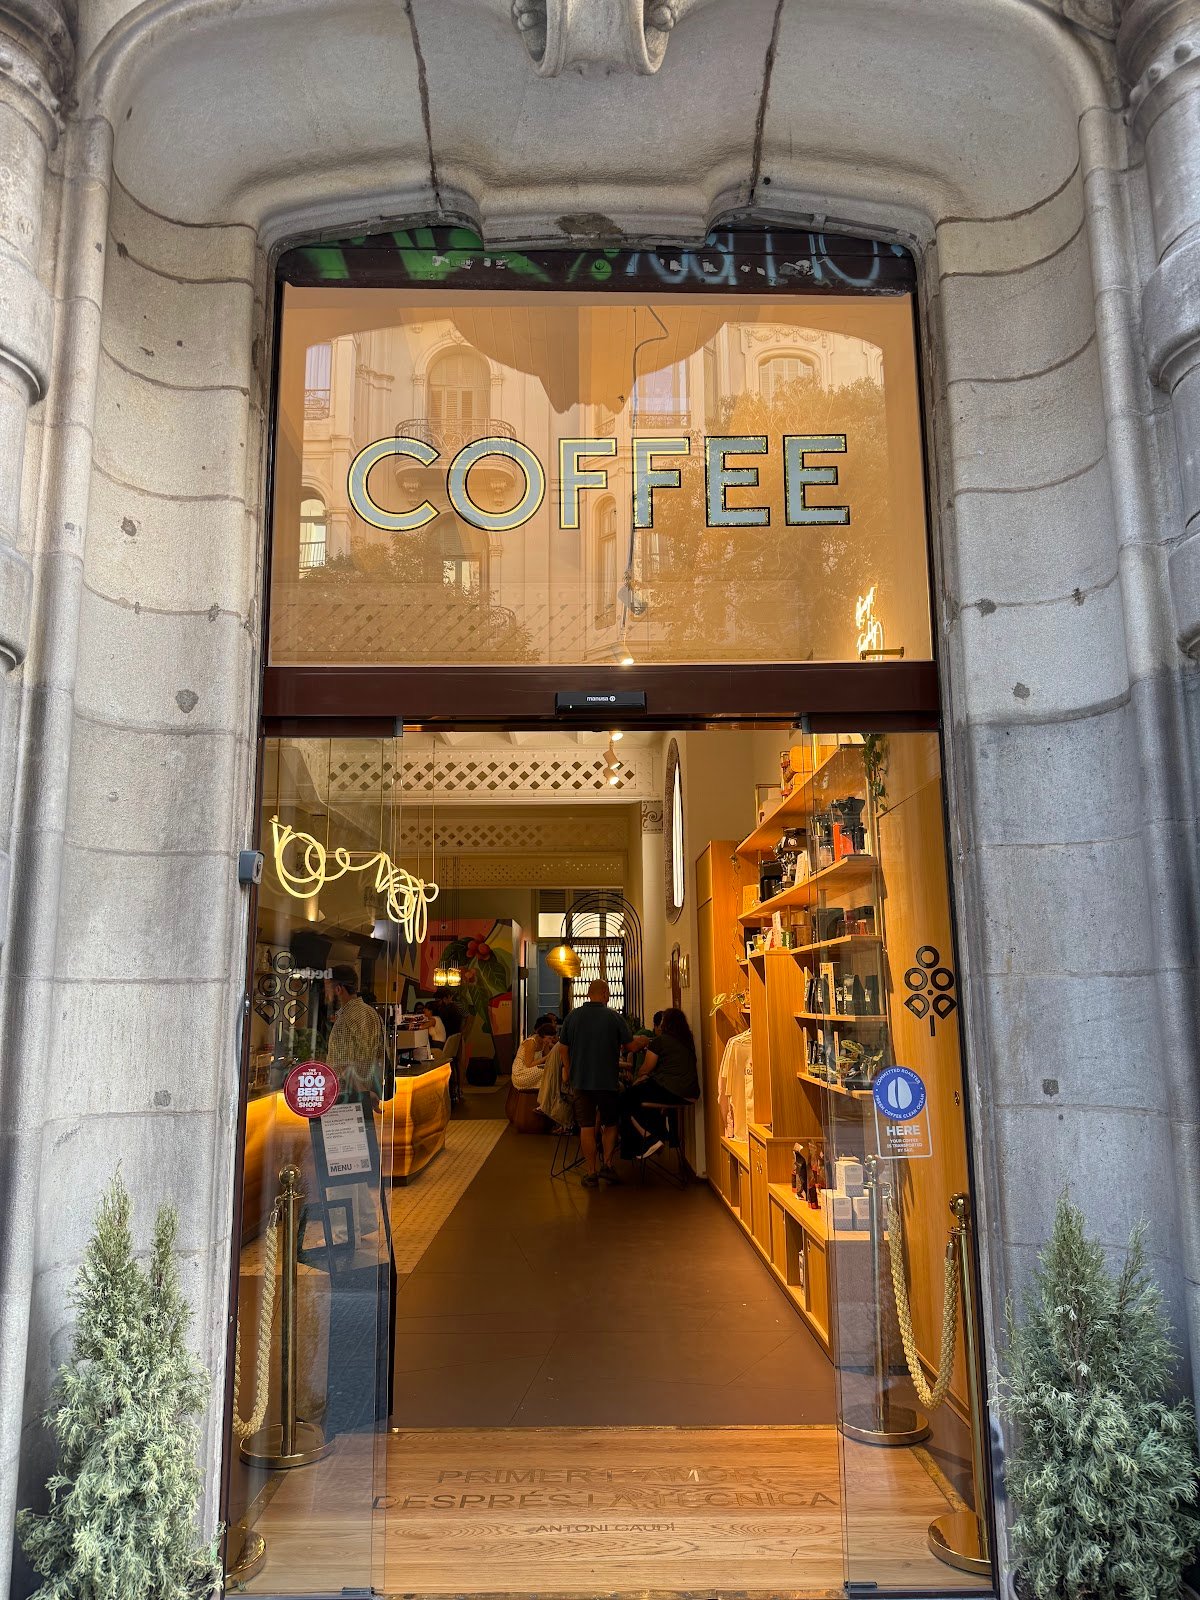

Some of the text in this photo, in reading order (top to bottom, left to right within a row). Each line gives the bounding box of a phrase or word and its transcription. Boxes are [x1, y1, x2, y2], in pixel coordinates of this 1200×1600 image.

[347, 434, 850, 531] COFFEE
[298, 1075, 325, 1088] 100
[876, 1068, 921, 1086] COMMITTED ROASTER
[298, 1088, 325, 1096] BEST
[884, 1109, 903, 1119] COFFEE
[902, 1108, 918, 1118] CLEAN
[916, 1093, 925, 1110] OCEAN
[886, 1125, 921, 1136] HERE
[330, 1164, 353, 1173] MENU
[436, 1469, 593, 1484] PRIMER
[371, 1490, 577, 1510] DESPRÉS
[535, 1524, 609, 1533] ANTONI
